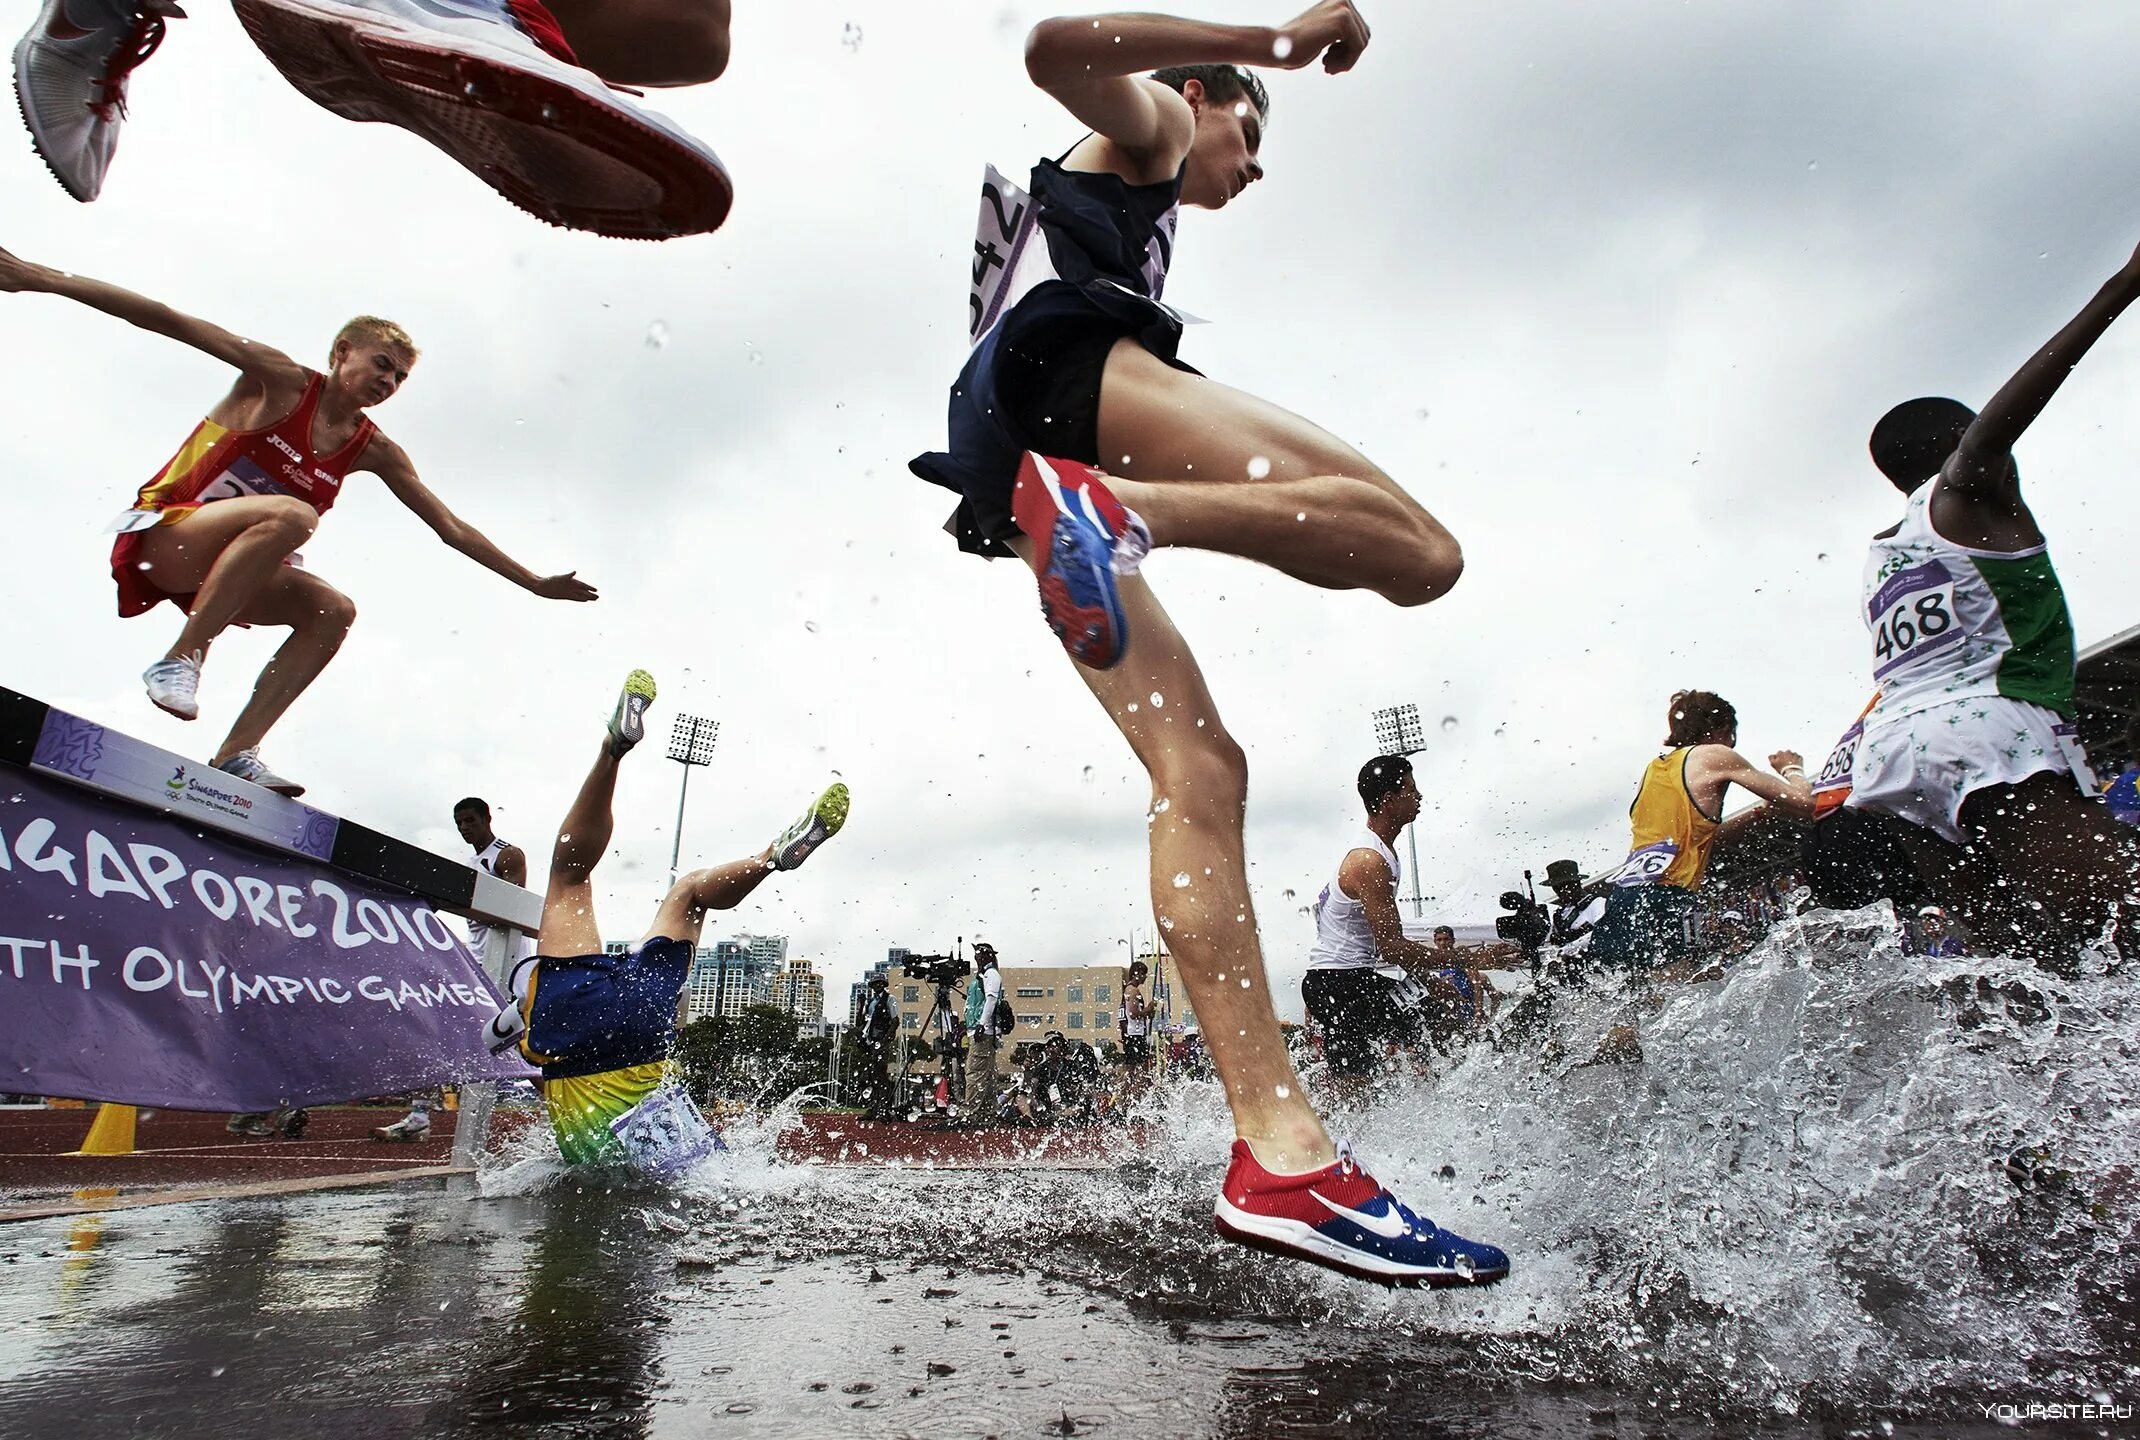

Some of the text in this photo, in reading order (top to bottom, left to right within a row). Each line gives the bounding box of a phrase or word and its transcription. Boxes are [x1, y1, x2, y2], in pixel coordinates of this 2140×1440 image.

[1876, 593, 1951, 661] 468
[1820, 741, 1855, 781] 698
[233, 794, 253, 810] 2010
[311, 878, 455, 952] 2010
[0, 936, 497, 1013] TH OLYMPIC GAMES
